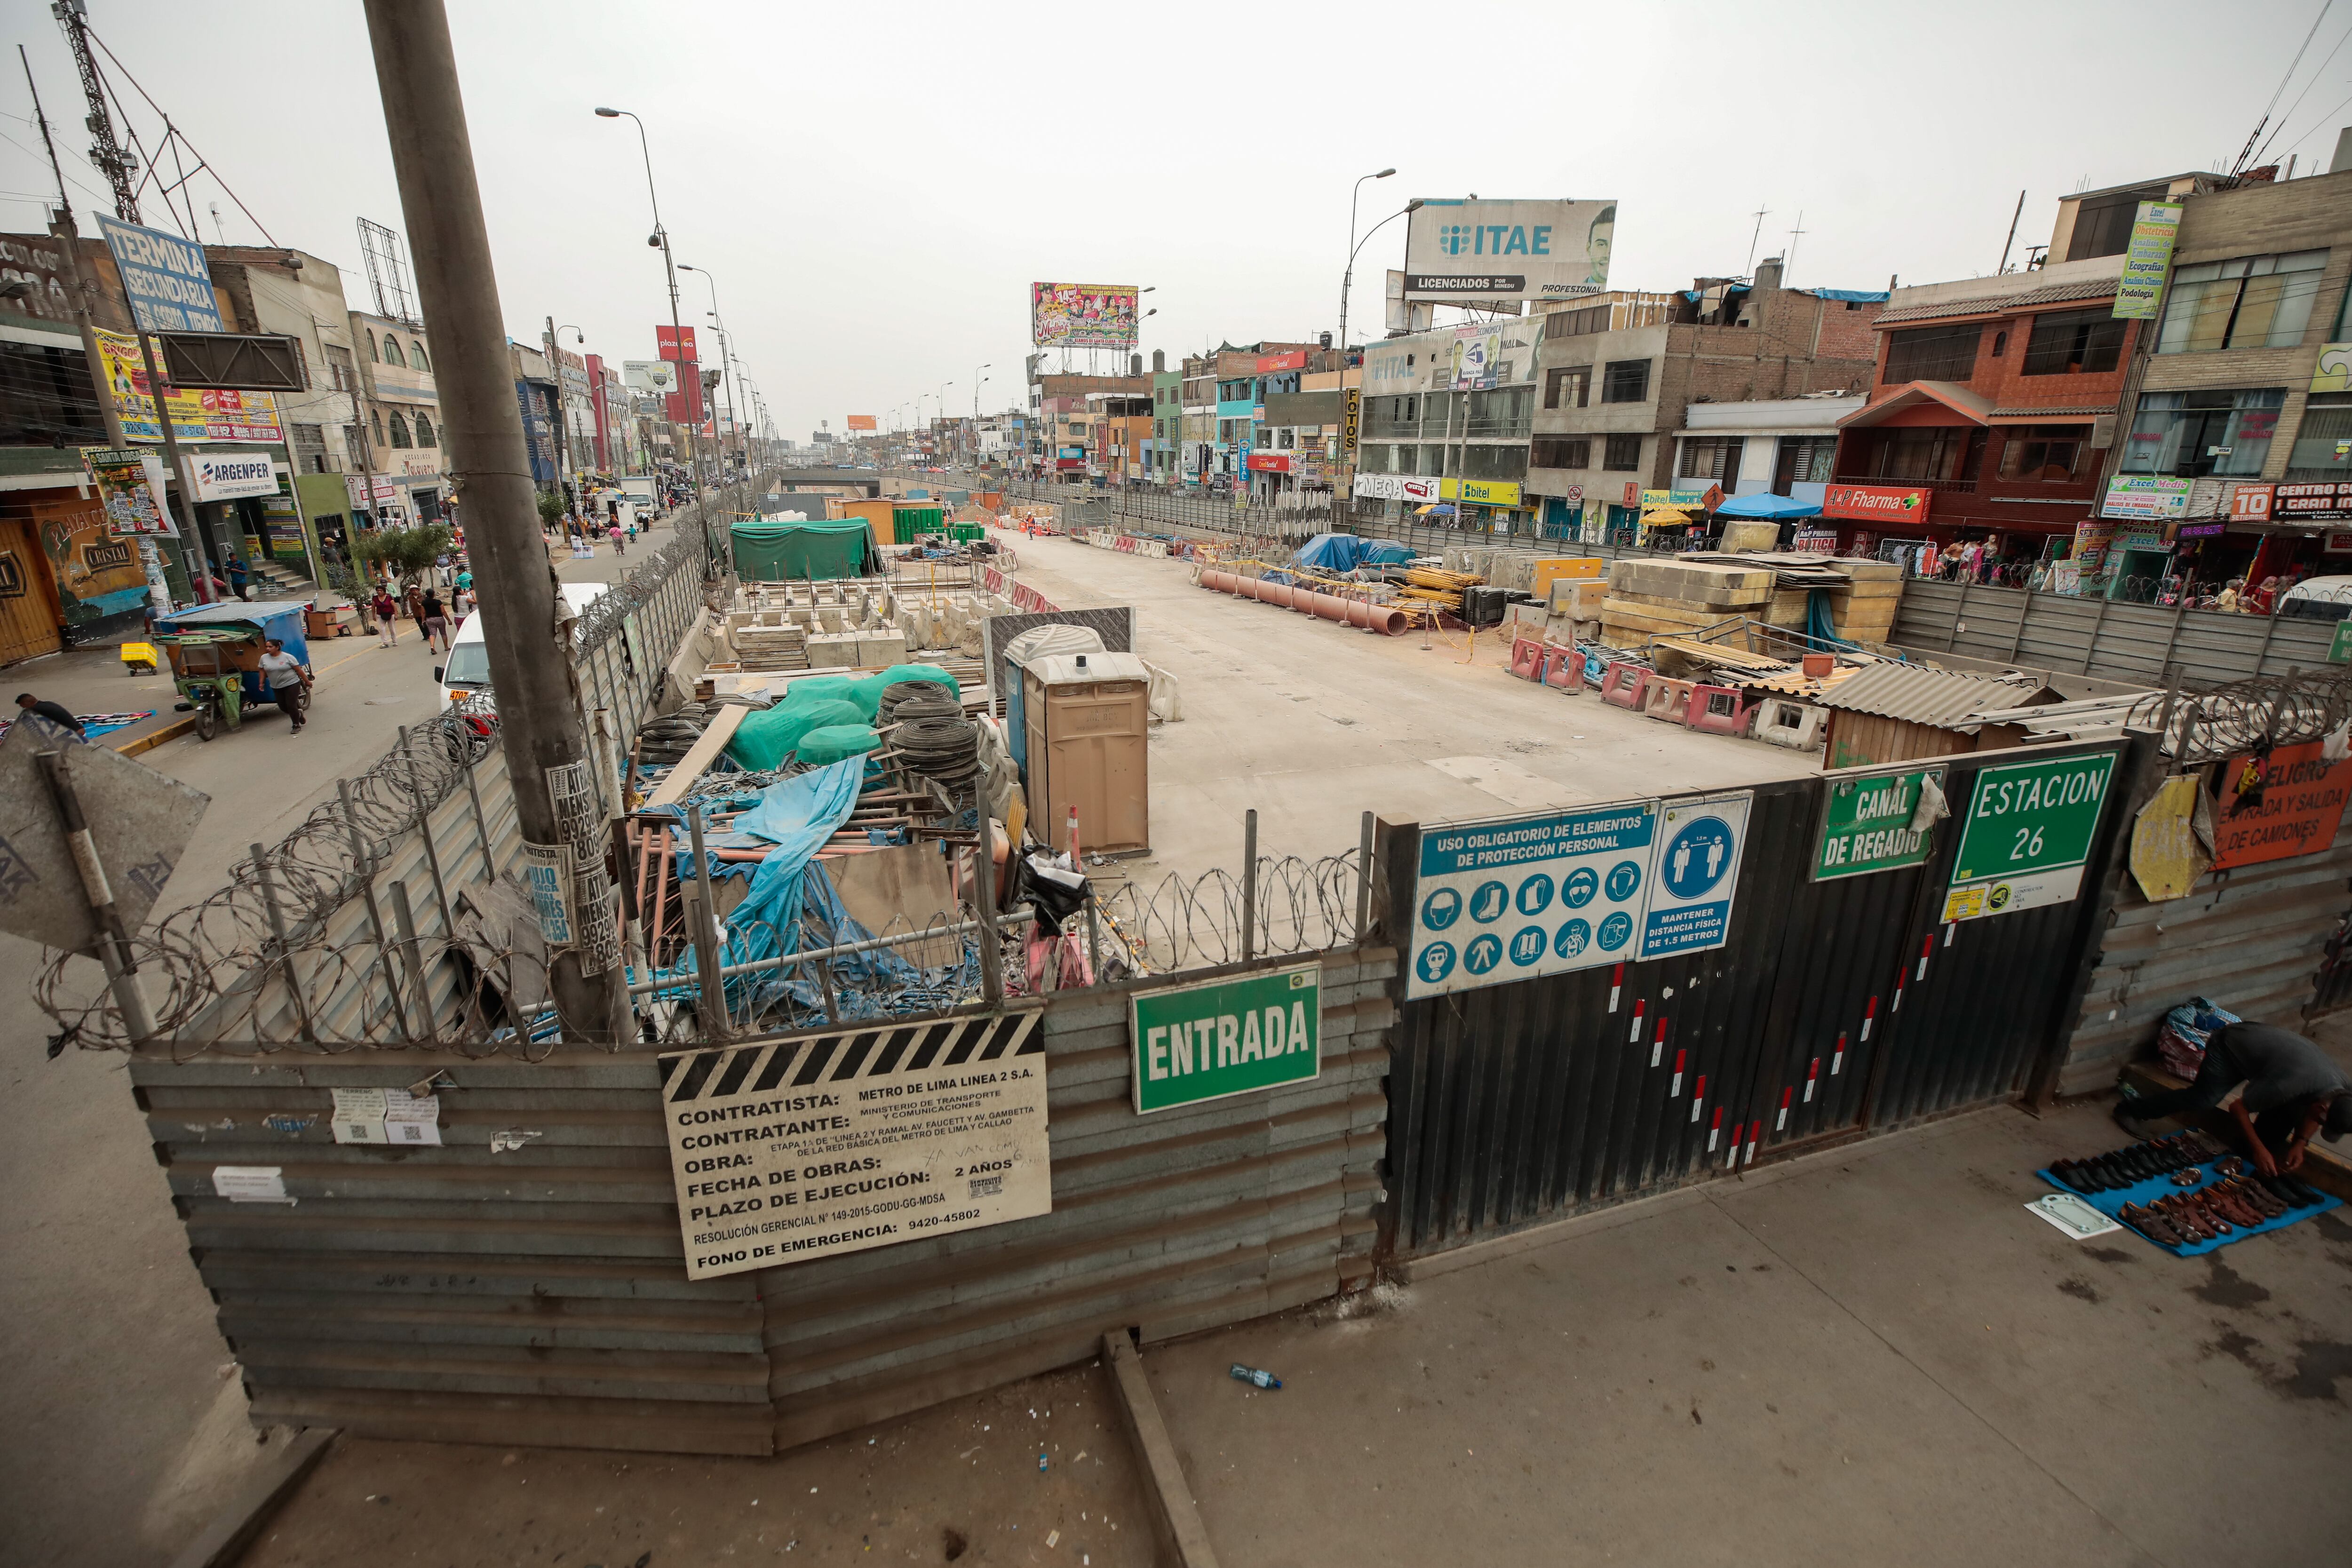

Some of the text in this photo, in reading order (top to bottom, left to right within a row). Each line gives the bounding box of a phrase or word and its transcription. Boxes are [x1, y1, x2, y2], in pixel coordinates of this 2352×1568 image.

[2150, 207, 2165, 217] Excel
[1474, 225, 1552, 255] ITAE
[104, 223, 208, 281] TERMINA
[2131, 248, 2166, 259] Embarazo
[125, 266, 214, 310] SECUNDARIA
[1418, 278, 1490, 288] LICENCIADOS
[1541, 284, 1601, 294] PROFESIONAL
[1057, 290, 1069, 302] 14
[1477, 325, 1501, 335] ECONÓMICA
[1269, 360, 1287, 369] CrediScotia
[1346, 390, 1357, 448] FOTOS
[2132, 433, 2162, 441] PODOLOGIA
[2238, 430, 2273, 438] EMBARAZO
[96, 452, 119, 463] SANTA
[121, 450, 140, 462] ROSA
[215, 462, 269, 481] ARGENPER
[1363, 477, 1404, 496] MEGA
[1407, 483, 1426, 493] OFERTAS
[1471, 486, 1489, 499] bitel
[2128, 478, 2187, 489] Excel Medic
[2276, 484, 2336, 496] CENTRO
[1649, 494, 1669, 503] bitel
[1827, 489, 1901, 510] A&P Fharma
[1922, 491, 1931, 522] BOTICA
[2235, 494, 2269, 514] 10
[2287, 498, 2332, 509] GRAN
[51, 511, 90, 550] PLAYA
[2099, 528, 2115, 537] SHOP
[2128, 535, 2154, 545] Excel
[88, 541, 128, 565] CRISTAL
[1856, 786, 1908, 821] CANAL
[1977, 769, 2105, 819] ESTACION
[2286, 788, 2343, 813] Y SALIDA
[1438, 815, 1642, 852] USO OBLIGATORIO DE ELEMENTOS
[2009, 825, 2045, 861] 26
[2228, 819, 2320, 850] DE CAMIONES
[1457, 835, 1619, 867] DE PROTECCIÓN PERSONAL
[1824, 836, 1849, 866] DE
[1661, 908, 1714, 923] MANTENER
[1649, 918, 1722, 937] DISTANCIA FÍSICA
[1648, 929, 1719, 948] DE 1.5 METROS
[1147, 1000, 1309, 1082] ENTRADA
[677, 1068, 1033, 1126] CONTRATISTA: METRO DE LIMA LINEA 2 S.A.
[892, 1100, 981, 1119] COMUNICACIONES
[681, 1090, 1001, 1150] CONTRATANTE: MINISTERIO DE TRANSPORTE
[684, 1154, 753, 1174] OBRA:
[771, 1142, 800, 1152] ETAPA
[878, 1125, 909, 1136] RAMAL
[926, 1116, 964, 1129] FAUCETT
[989, 1106, 1034, 1120] GAMBETTA
[826, 1145, 844, 1153] RED
[847, 1138, 880, 1149] BÁSICA
[882, 1135, 898, 1144] DEL
[901, 1130, 932, 1141] METRO
[948, 1125, 968, 1134] LIMA
[978, 1118, 1012, 1129] CALLAO
[955, 1144, 984, 1158] VAN
[687, 1158, 882, 1198] FECHA DE OBRAS:
[691, 1159, 1013, 1222] PLAZO DE EJECUCIÓN: 2 AÑOS
[694, 1224, 758, 1245] RESOLUCIÓN
[761, 1215, 816, 1234] GERENCIAL
[831, 1193, 946, 1221] 149-2015-GODU-GG-MDSA
[697, 1209, 980, 1269] FONO DE EMERGENCIA: 9420-45802
